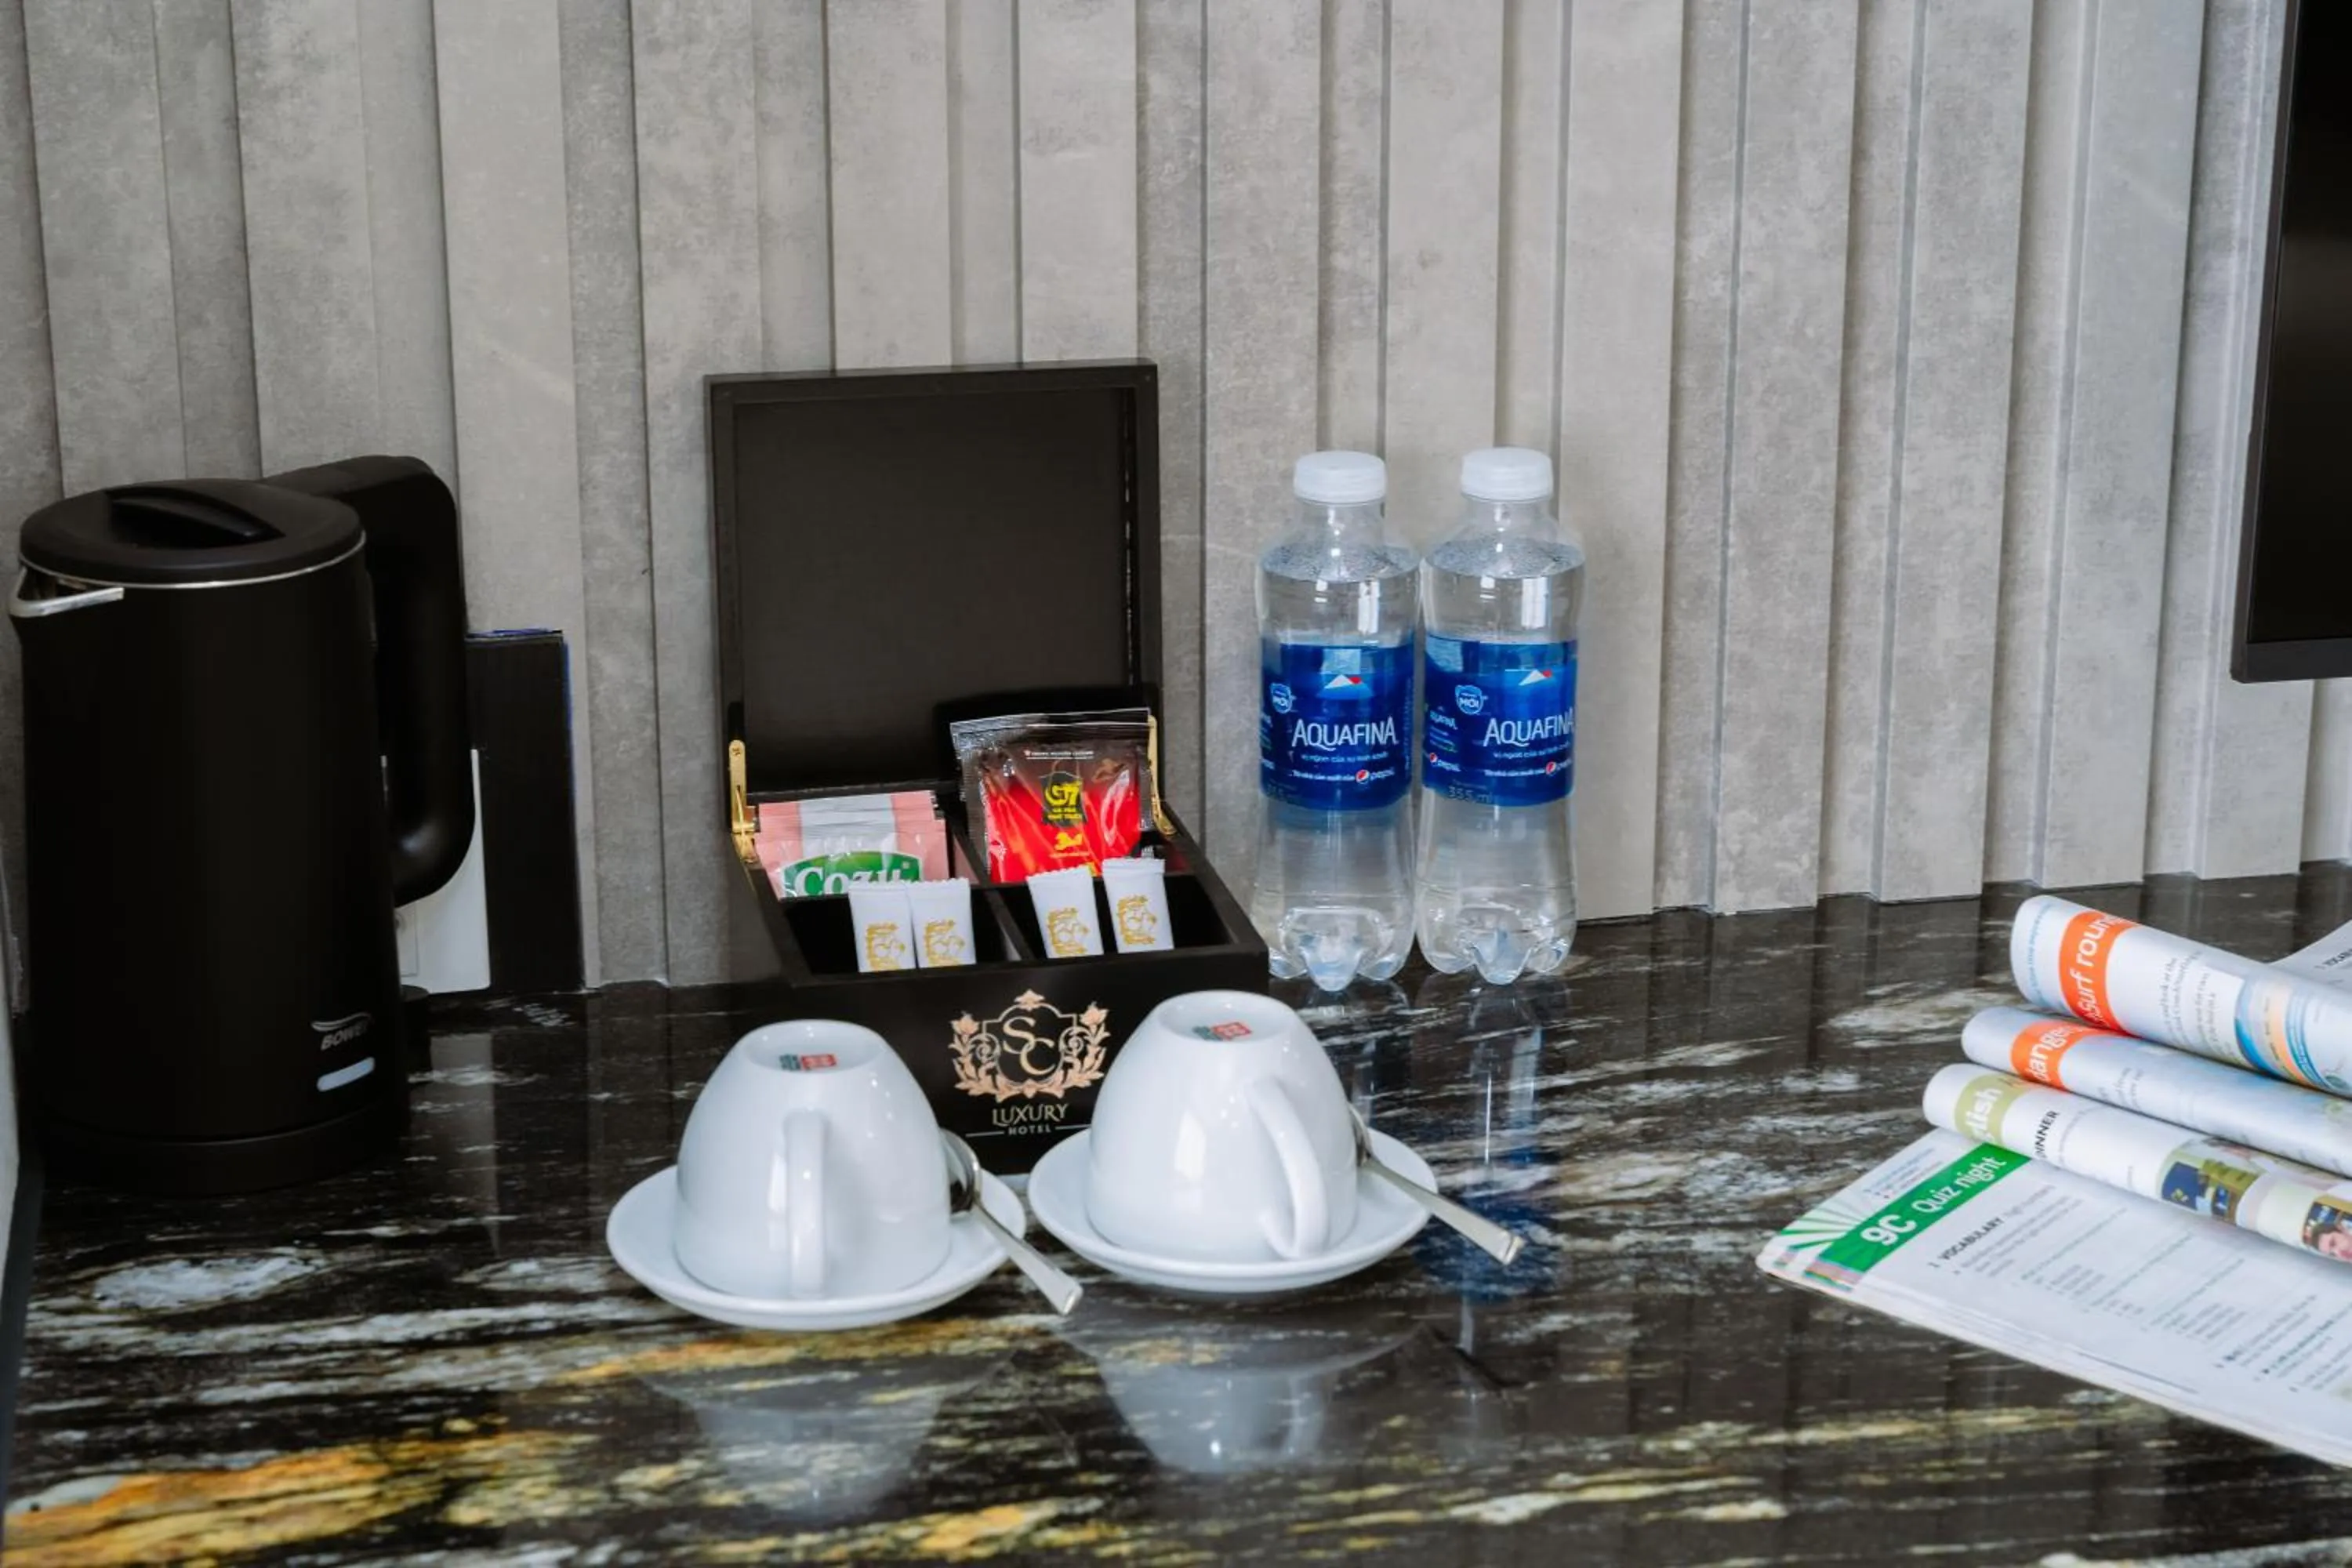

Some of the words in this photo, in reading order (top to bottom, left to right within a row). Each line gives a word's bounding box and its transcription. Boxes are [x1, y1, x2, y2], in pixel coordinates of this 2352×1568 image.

[1291, 716, 1397, 752] AQUAFINA
[794, 866, 901, 896] Co
[1003, 1016, 1056, 1076] SC
[992, 1103, 1069, 1127] LUXURY
[1008, 1124, 1052, 1136] HOTEL
[1860, 1214, 1918, 1247] 9C
[1911, 1185, 1963, 1214] Quiz
[1954, 1156, 2008, 1189] night
[1938, 1216, 2005, 1260] VOCABULARY
